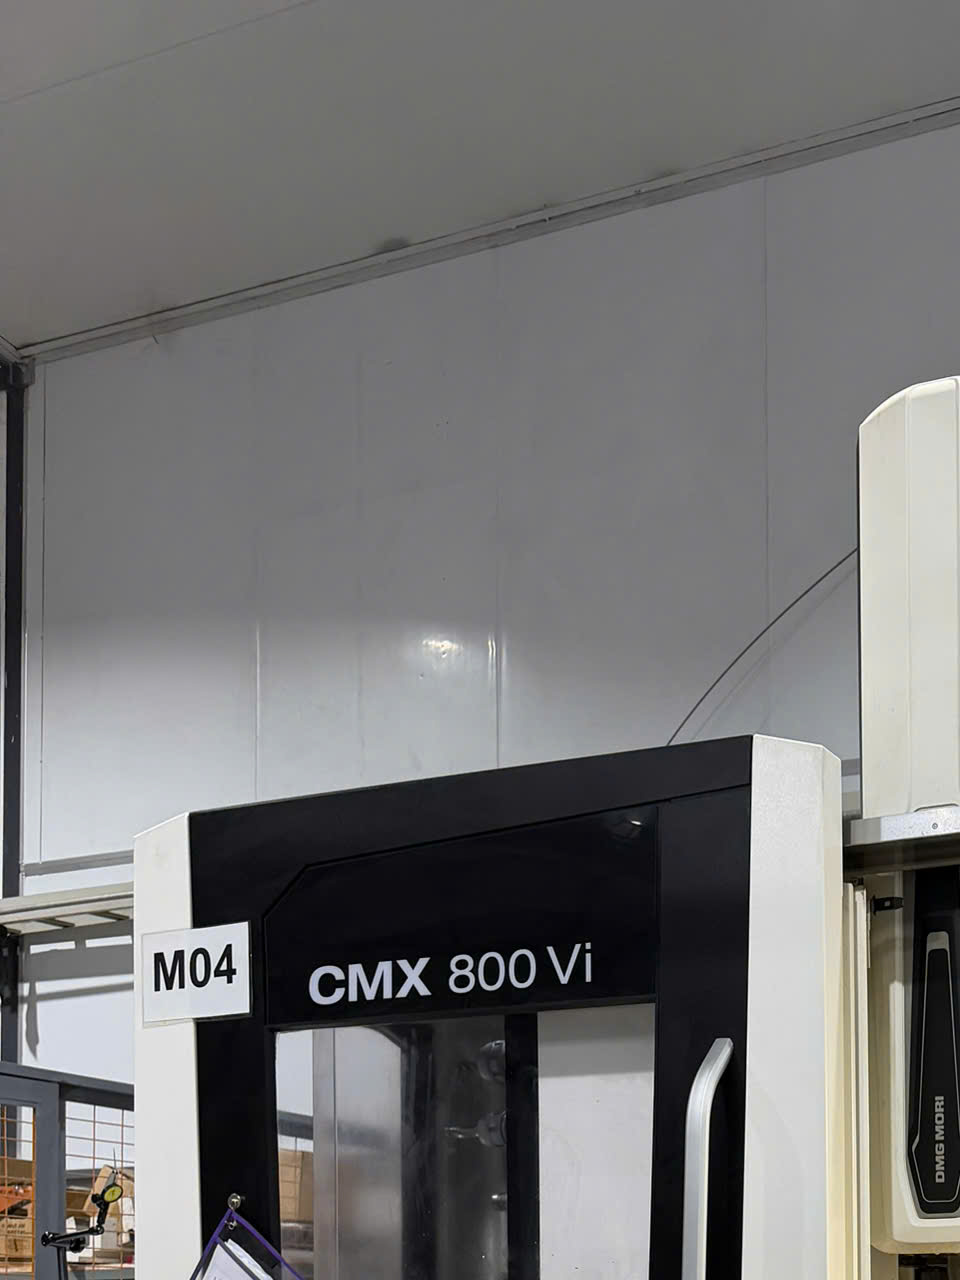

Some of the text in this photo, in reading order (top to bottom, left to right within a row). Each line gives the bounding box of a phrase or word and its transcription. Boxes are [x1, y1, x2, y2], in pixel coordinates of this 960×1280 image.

[153, 943, 237, 992] M04
[308, 942, 592, 1006] CMX 800 Vi
[934, 1095, 945, 1184] DMG MORI
